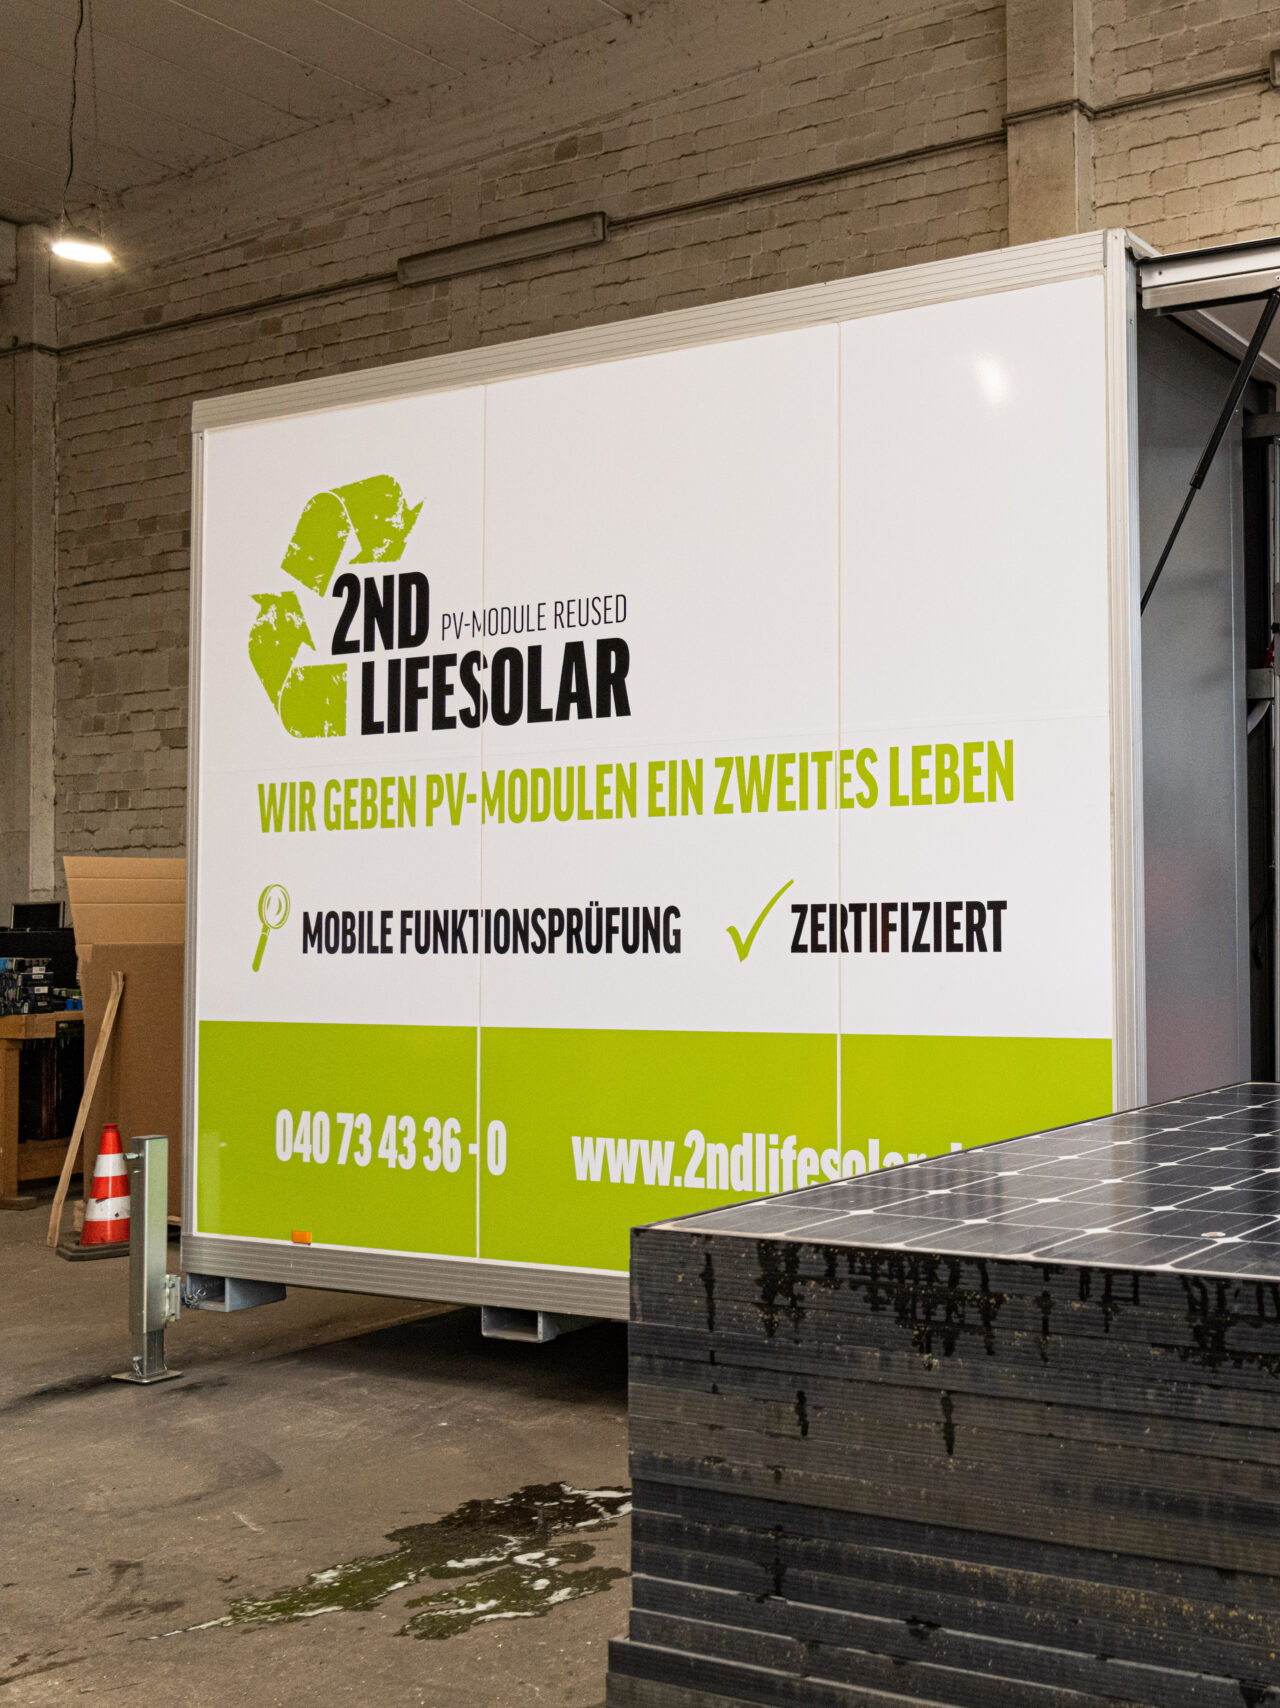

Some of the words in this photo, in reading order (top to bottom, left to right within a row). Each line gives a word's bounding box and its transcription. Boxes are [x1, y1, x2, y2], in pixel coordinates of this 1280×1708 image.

[332, 571, 430, 656] 2ND
[441, 602, 547, 641] PV-MODULE
[554, 594, 628, 629] REUSED
[361, 637, 631, 735] LIFESOLAR
[257, 780, 316, 833] WIR
[323, 775, 416, 831] GEBEN
[425, 762, 638, 827] PV-MODULEN
[648, 758, 703, 818] EIN
[713, 747, 879, 815] ZWEITES
[889, 739, 1014, 807] LEBEN
[302, 909, 394, 955] MOBILE
[400, 901, 681, 955] FUNKTIONSPRÜFUNG
[791, 900, 1008, 953] ZERTIFIZIERT
[275, 1108, 331, 1165] 040
[336, 1112, 372, 1167] 73
[378, 1115, 417, 1170] 43
